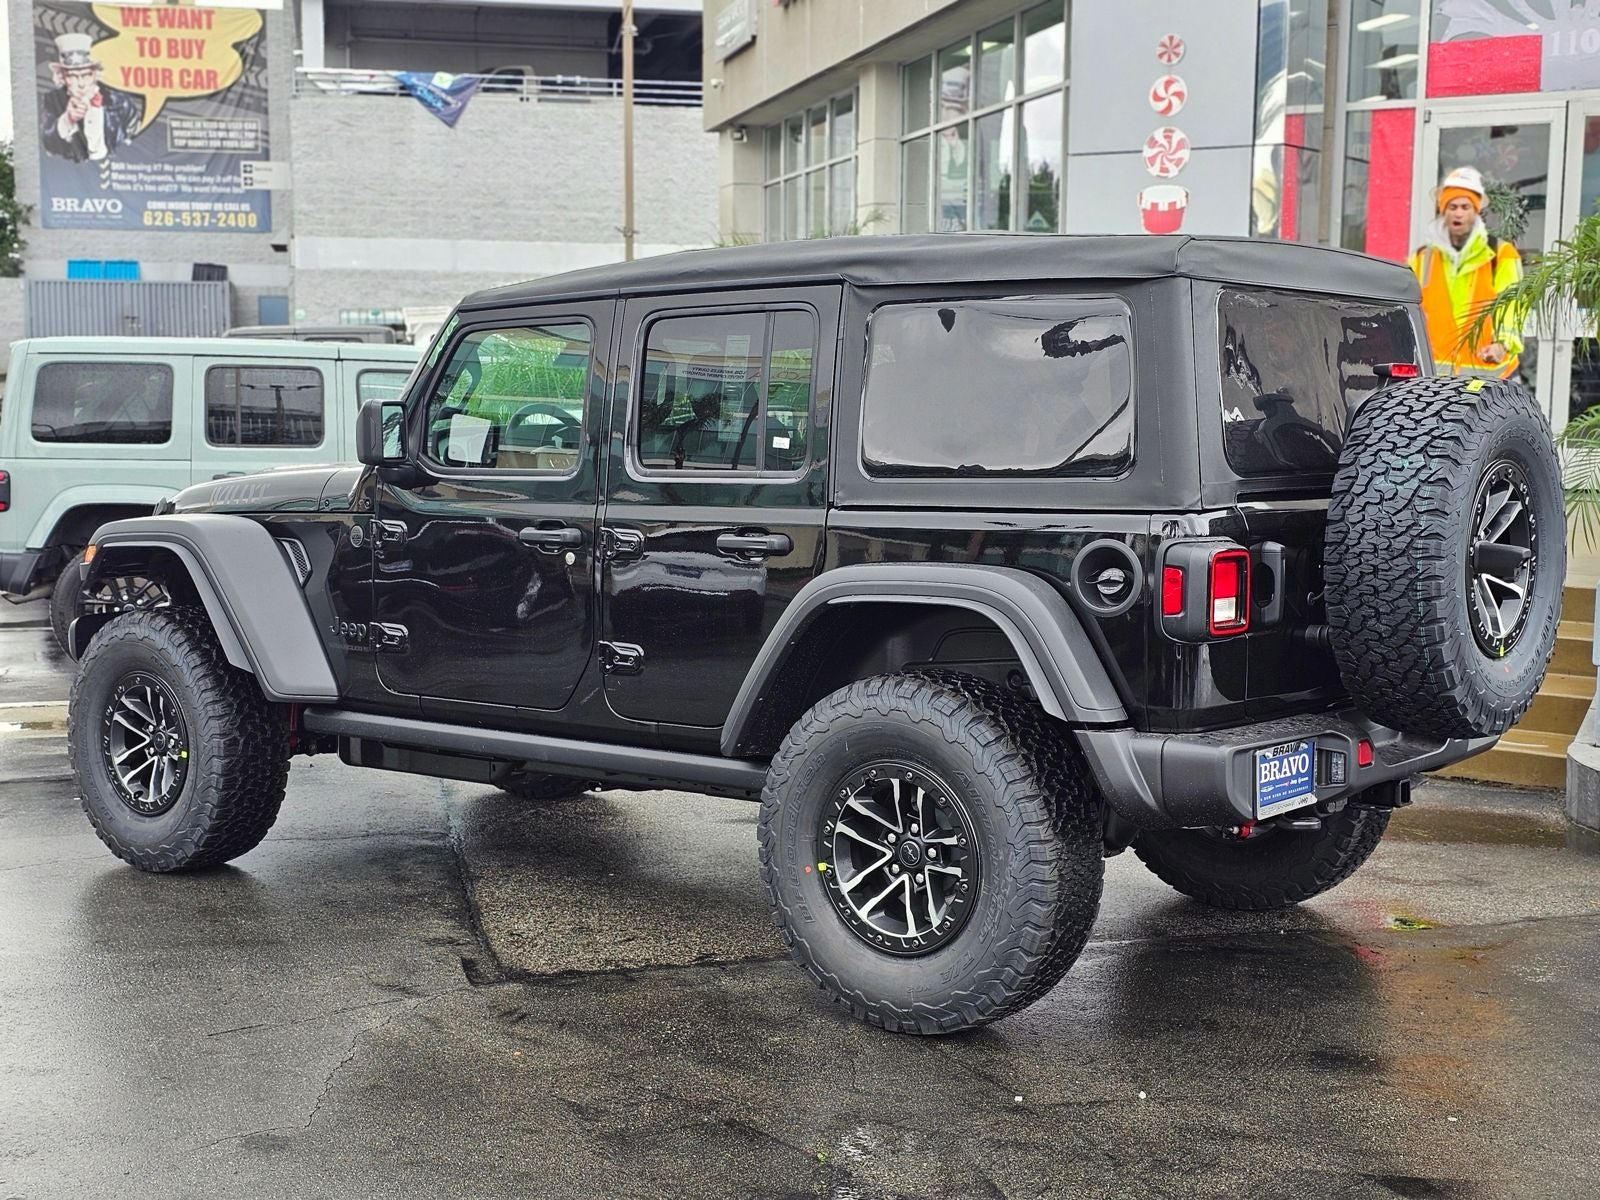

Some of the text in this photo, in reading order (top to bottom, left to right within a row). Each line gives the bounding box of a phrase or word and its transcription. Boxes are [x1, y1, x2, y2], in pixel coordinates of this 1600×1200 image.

[121, 7, 215, 31] WE WANT
[136, 36, 206, 60] TO BUY
[120, 66, 219, 90] YOUR CAR
[51, 197, 123, 214] BRAVO
[143, 210, 258, 228] 626-537-2400
[329, 616, 367, 641] Jeep
[1260, 754, 1309, 784] BRAVO
